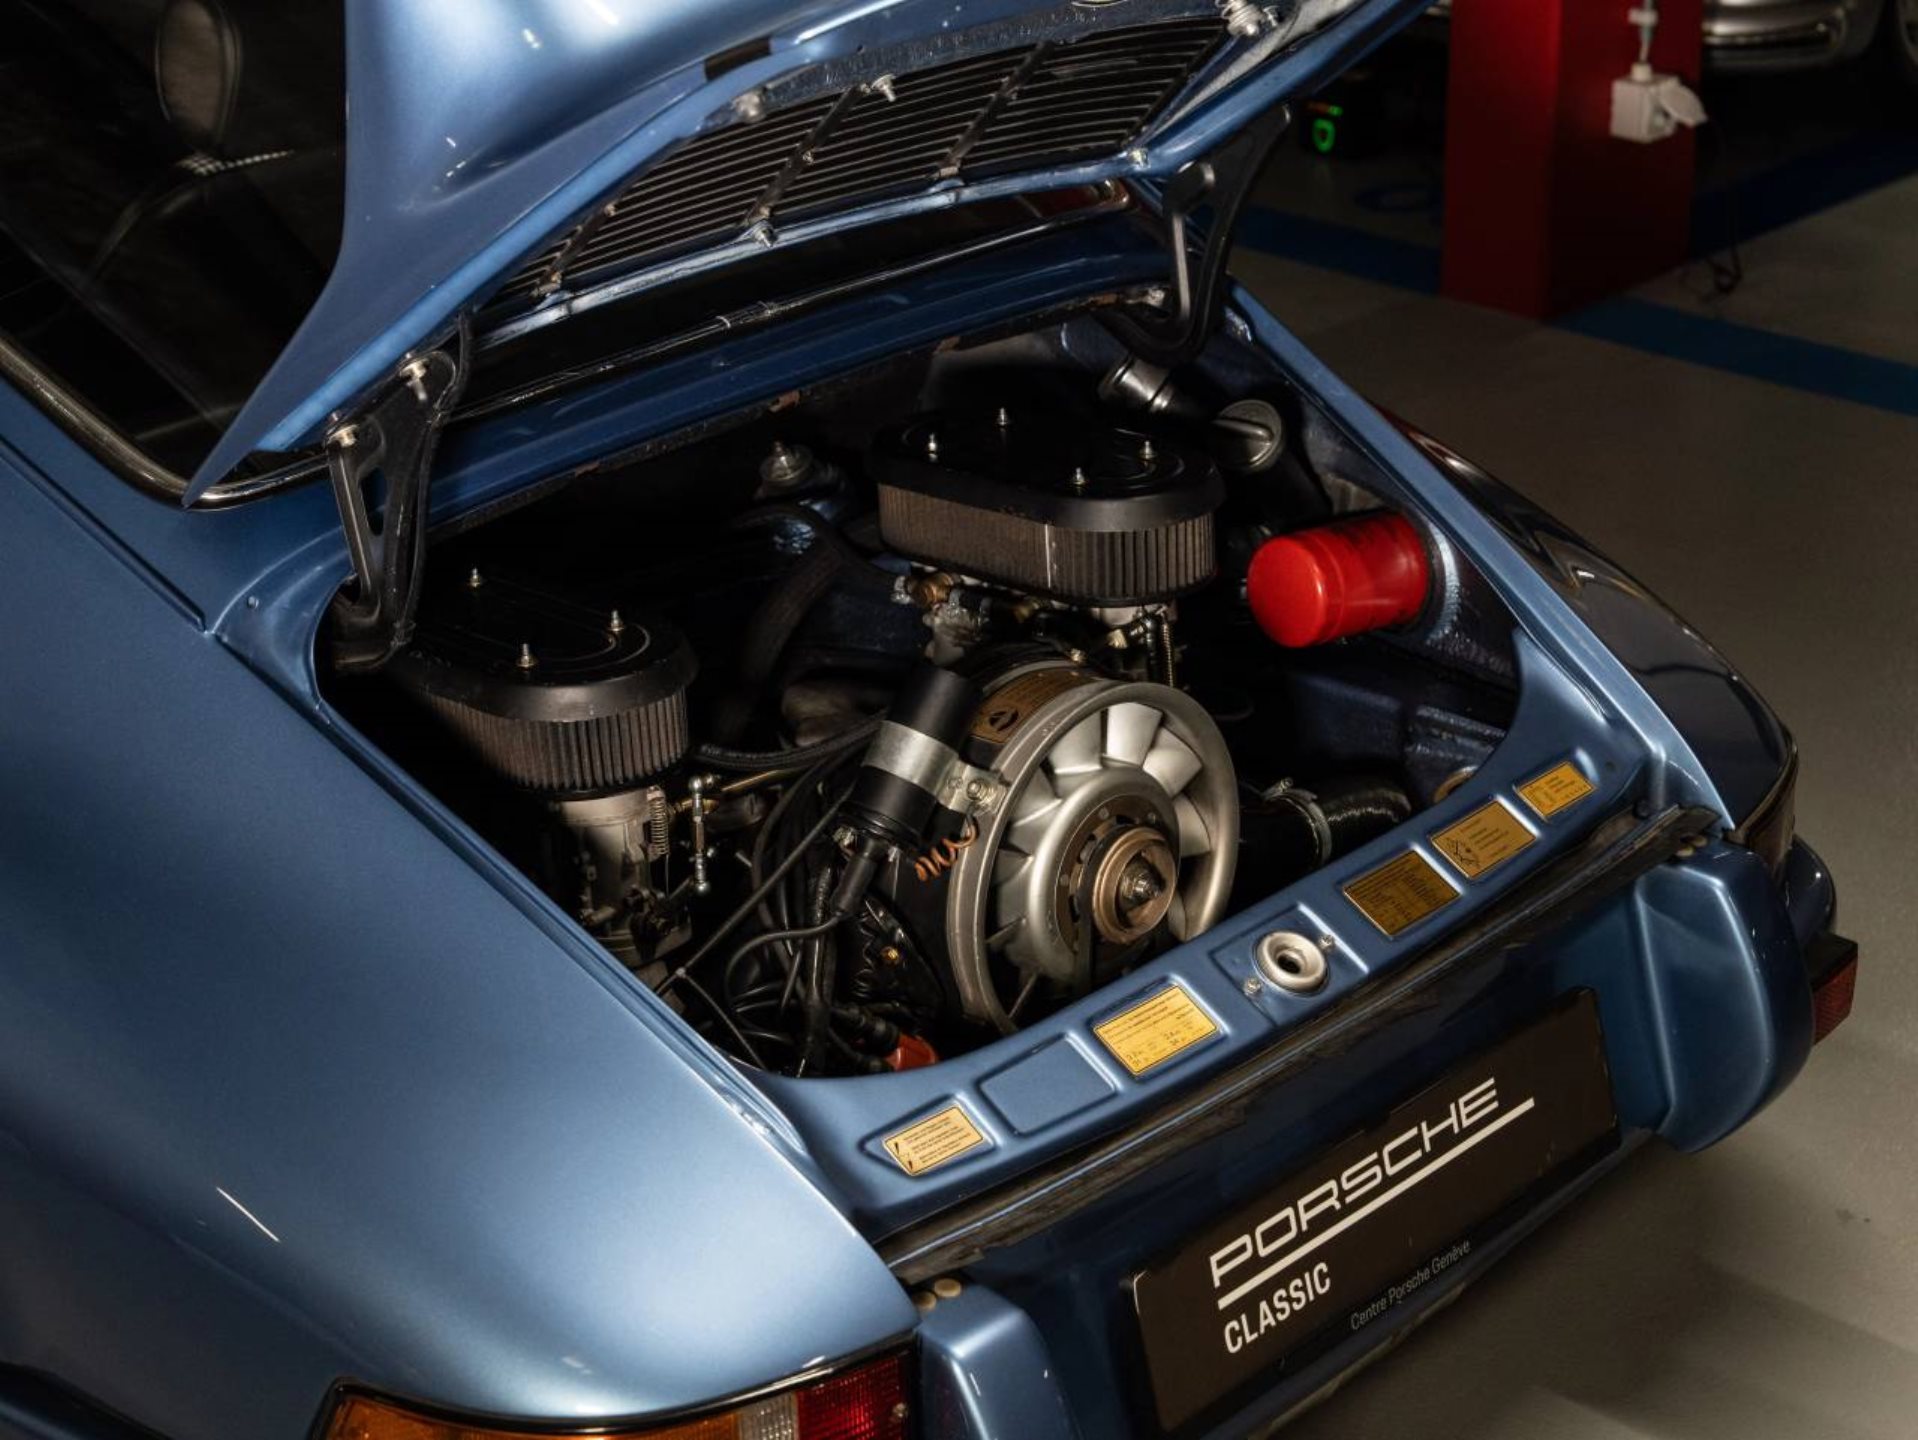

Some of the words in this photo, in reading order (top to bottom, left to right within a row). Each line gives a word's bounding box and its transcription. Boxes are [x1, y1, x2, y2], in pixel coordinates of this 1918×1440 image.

[1210, 1078, 1499, 1288] PORSCHE
[1224, 1262, 1331, 1354] CLASSIC
[1350, 1296, 1387, 1330] Centre
[1388, 1268, 1430, 1304] Porsche
[1431, 1240, 1470, 1274] Genève
